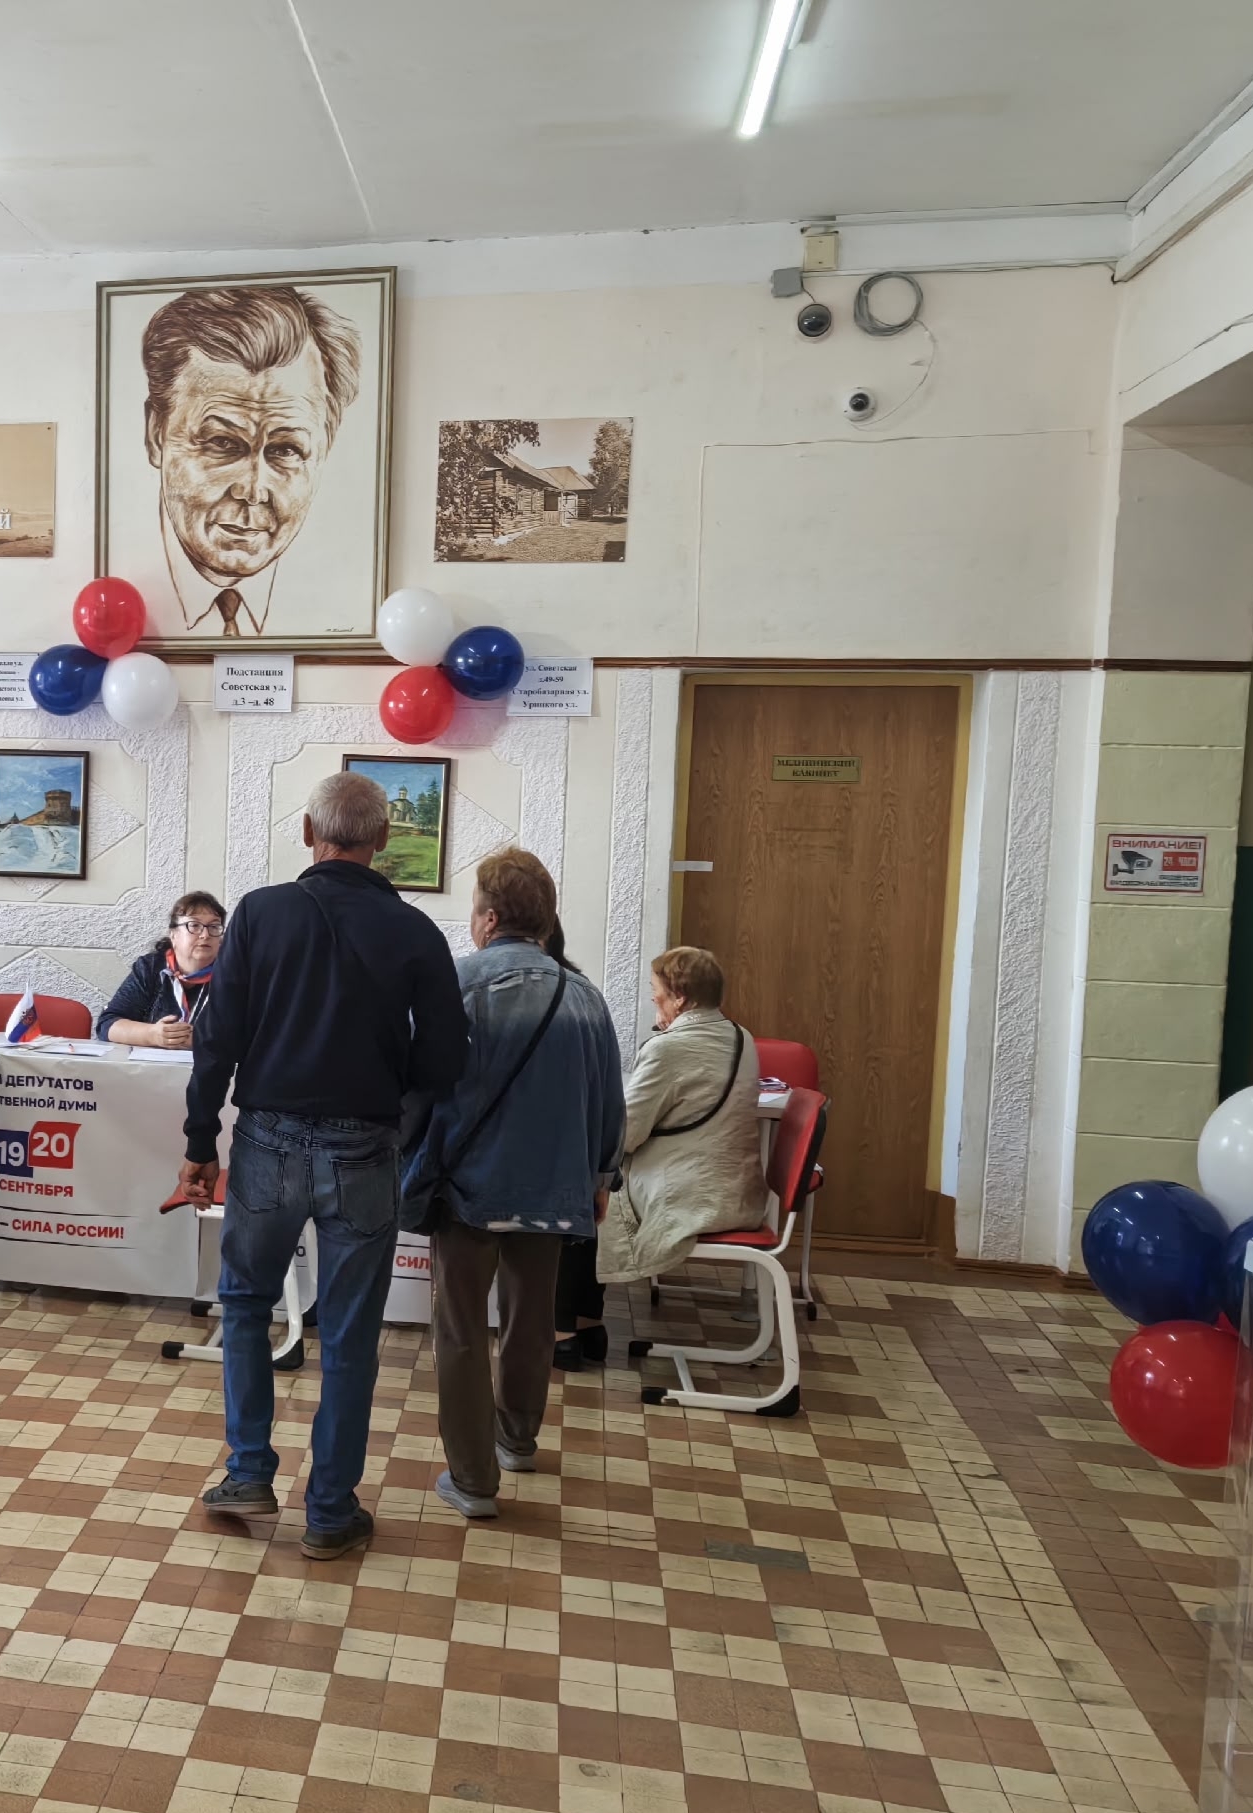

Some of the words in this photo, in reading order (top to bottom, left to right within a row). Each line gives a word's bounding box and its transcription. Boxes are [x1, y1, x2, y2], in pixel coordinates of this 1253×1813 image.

[227, 667, 283, 676] Подстанция
[221, 682, 270, 691] Советская
[1112, 840, 1202, 850] ВНИМАНИЕ!
[5, 1074, 94, 1091] ДЕПУТАТОВ
[58, 1100, 97, 1111] ДУМЫ
[32, 1131, 71, 1158] 20
[12, 1218, 53, 1234] СИЛА
[56, 1223, 124, 1239] РОССИИ!
[395, 1255, 430, 1270] СИЛ
